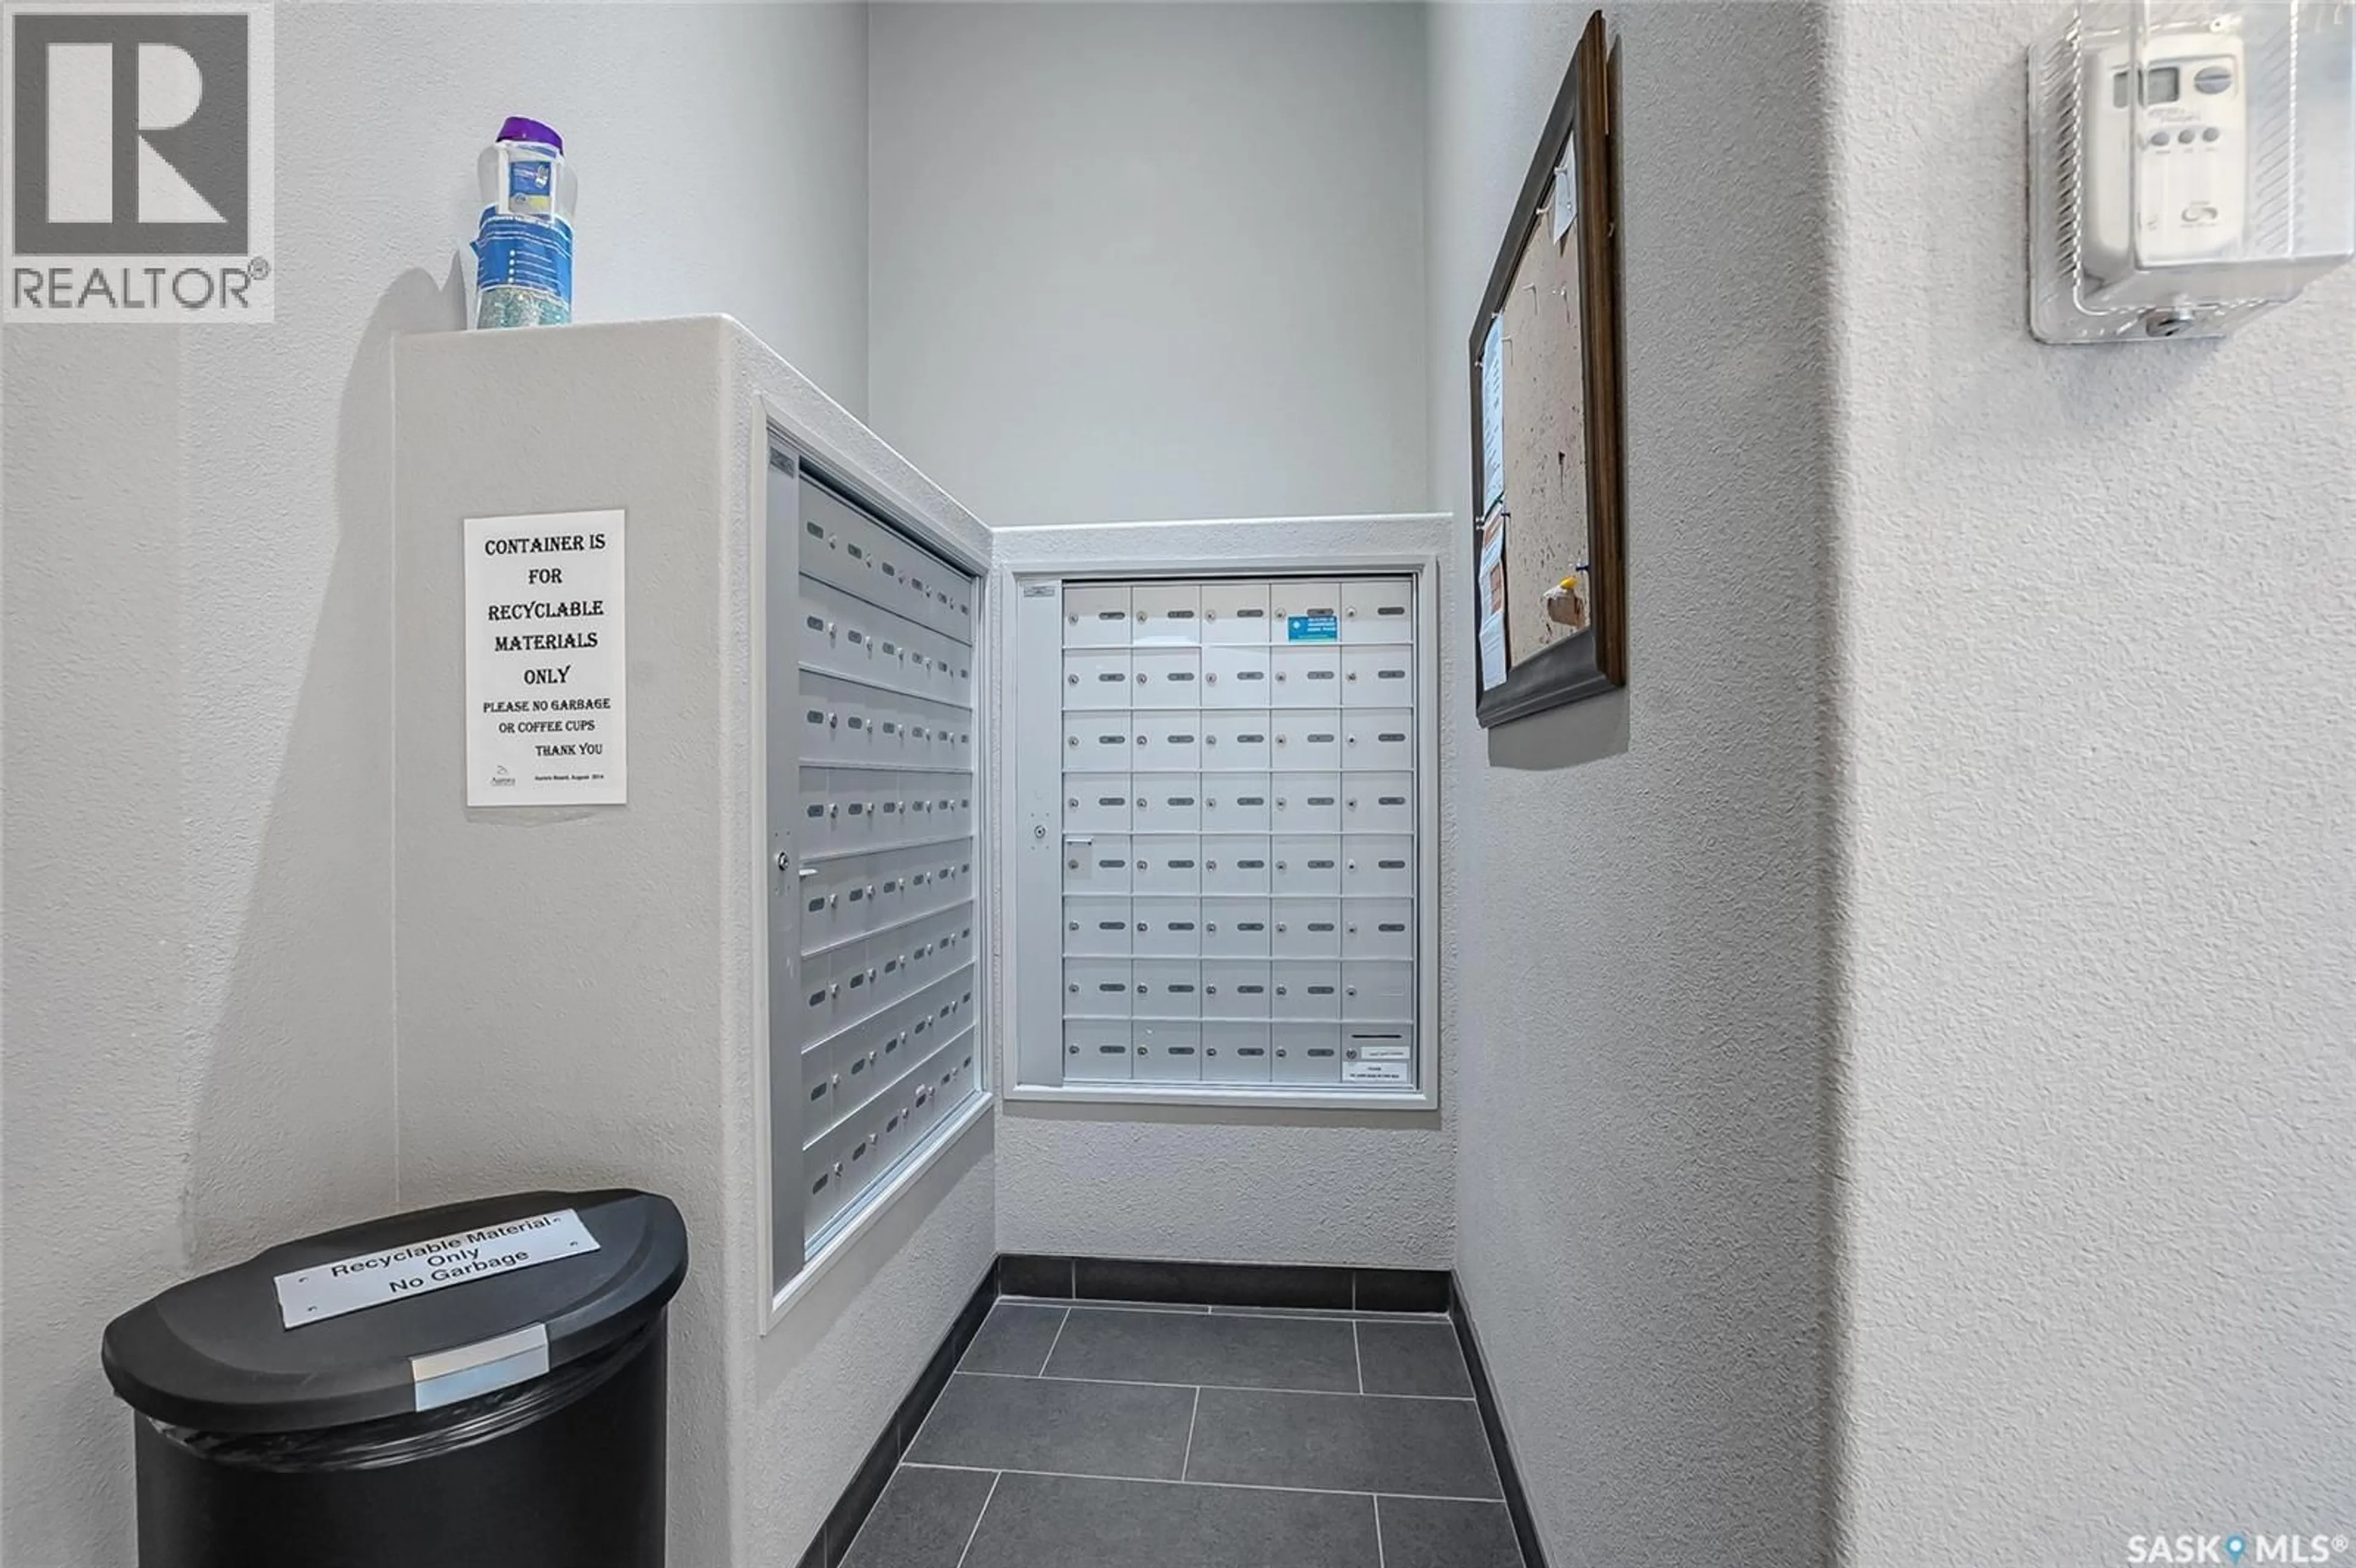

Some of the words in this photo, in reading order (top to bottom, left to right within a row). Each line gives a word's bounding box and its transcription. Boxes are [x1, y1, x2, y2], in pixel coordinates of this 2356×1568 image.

[485, 535, 585, 556] CONTAINER
[589, 533, 606, 550] IS
[528, 568, 563, 585] FOR
[488, 600, 604, 621] RECYCLABLE
[495, 632, 598, 652] MATERIALS
[523, 664, 572, 685] ONLY
[483, 701, 529, 713] PLEASE
[532, 701, 549, 712] NO
[550, 698, 611, 711] GARBAGE
[498, 722, 515, 734] OR
[517, 721, 563, 733] COFFEE
[565, 720, 595, 732] CUPS
[534, 744, 576, 756] THANK
[579, 742, 603, 755] YOU
[331, 1238, 462, 1278] Recyclable
[466, 1216, 552, 1244] Material
[426, 1247, 480, 1267] Only
[388, 1277, 424, 1293] No
[430, 1250, 530, 1283] Garbage
